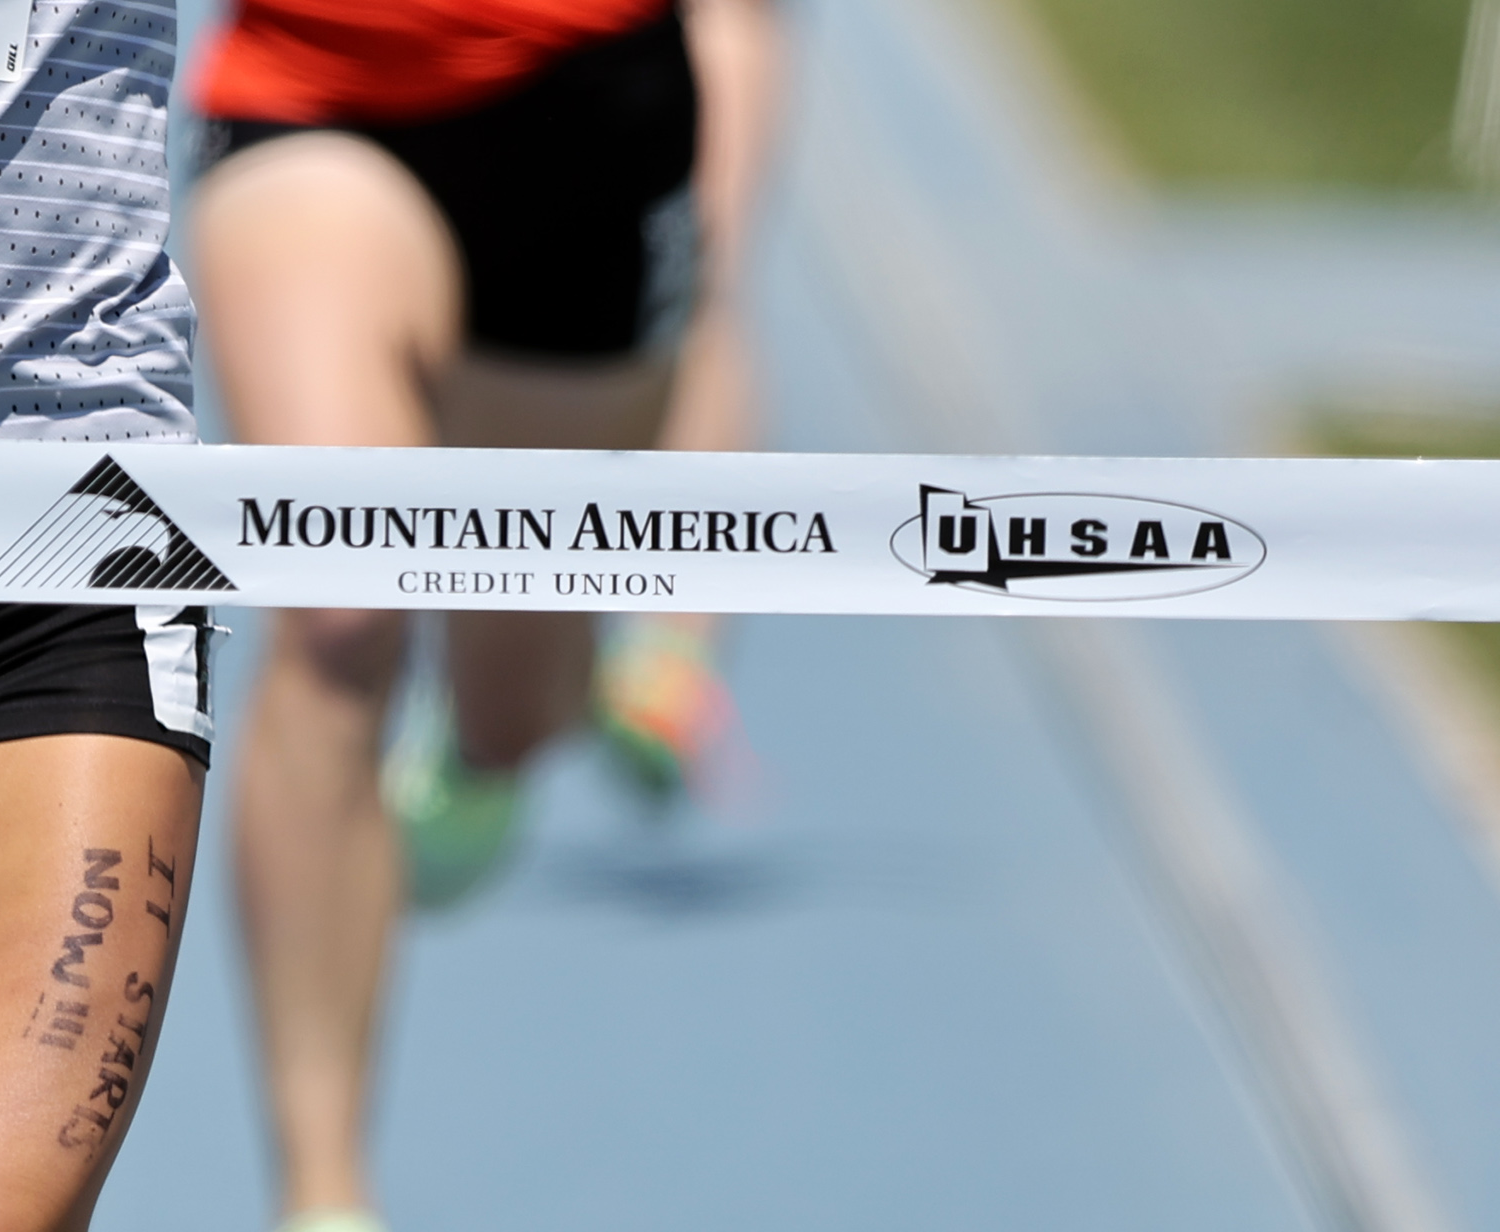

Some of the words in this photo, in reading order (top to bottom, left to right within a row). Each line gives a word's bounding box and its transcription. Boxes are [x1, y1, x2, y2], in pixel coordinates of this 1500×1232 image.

[7, 43, 18, 72] GILL
[237, 497, 555, 551] MOUNTAIN
[569, 502, 838, 554] AMERICA
[938, 514, 1232, 561] UHSAA
[397, 571, 535, 595] CREDIT
[554, 572, 678, 597] UNION
[145, 834, 176, 940] IT
[58, 970, 155, 1163] STARTS
